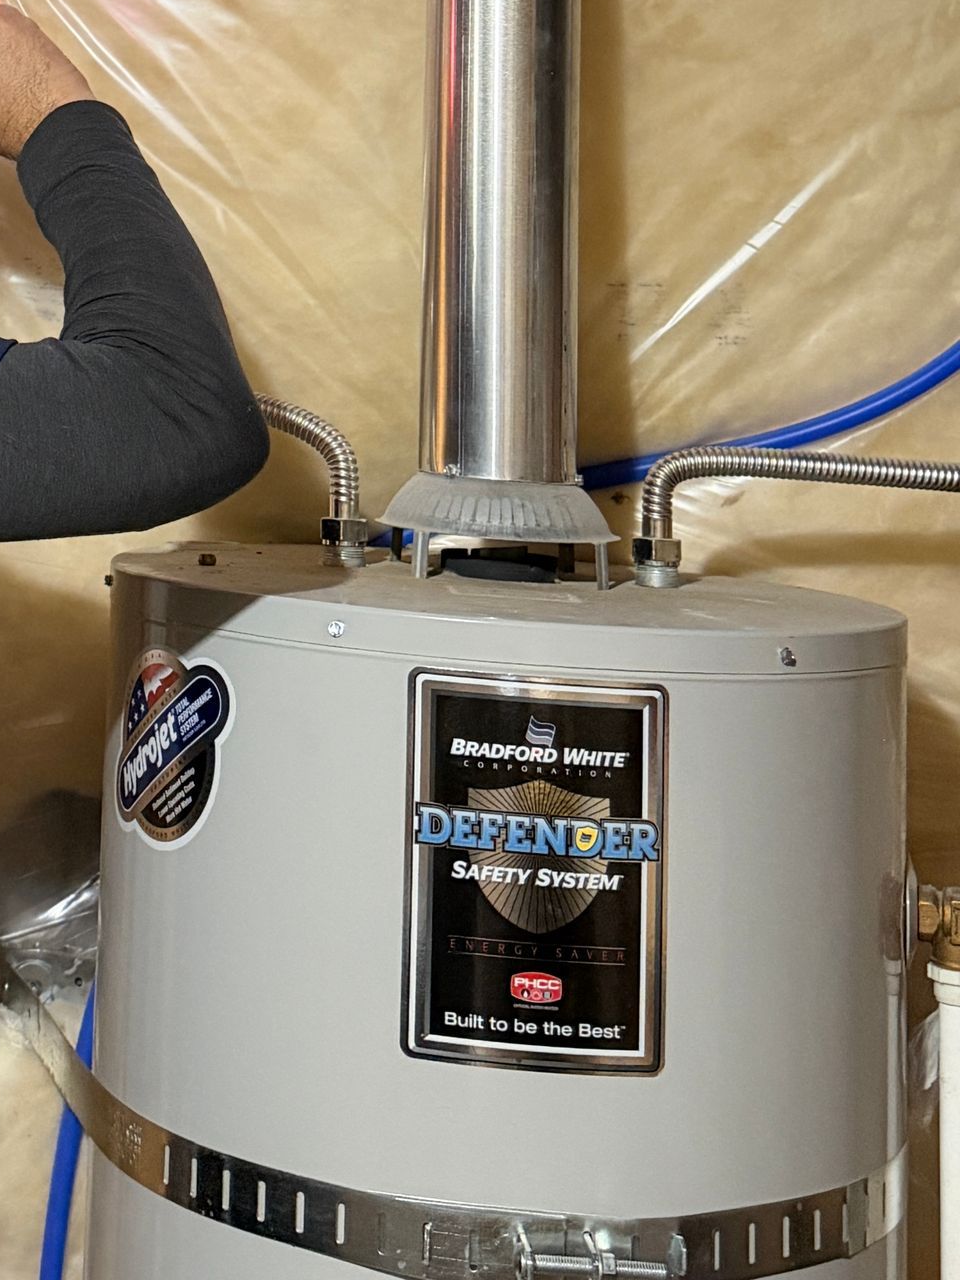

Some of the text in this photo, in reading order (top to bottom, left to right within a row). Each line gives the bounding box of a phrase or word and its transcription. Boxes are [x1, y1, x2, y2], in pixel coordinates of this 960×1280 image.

[123, 711, 178, 798] Hydrojet
[450, 738, 626, 768] BRADFORD WHITE
[463, 759, 612, 778] CORPORATION
[417, 804, 658, 860] DEFENDER
[451, 860, 620, 891] SAFETY SYSTEM
[449, 938, 625, 961] ENERGY SAVER
[514, 977, 561, 990] PHCC
[444, 1011, 622, 1039] Built to be the Best
